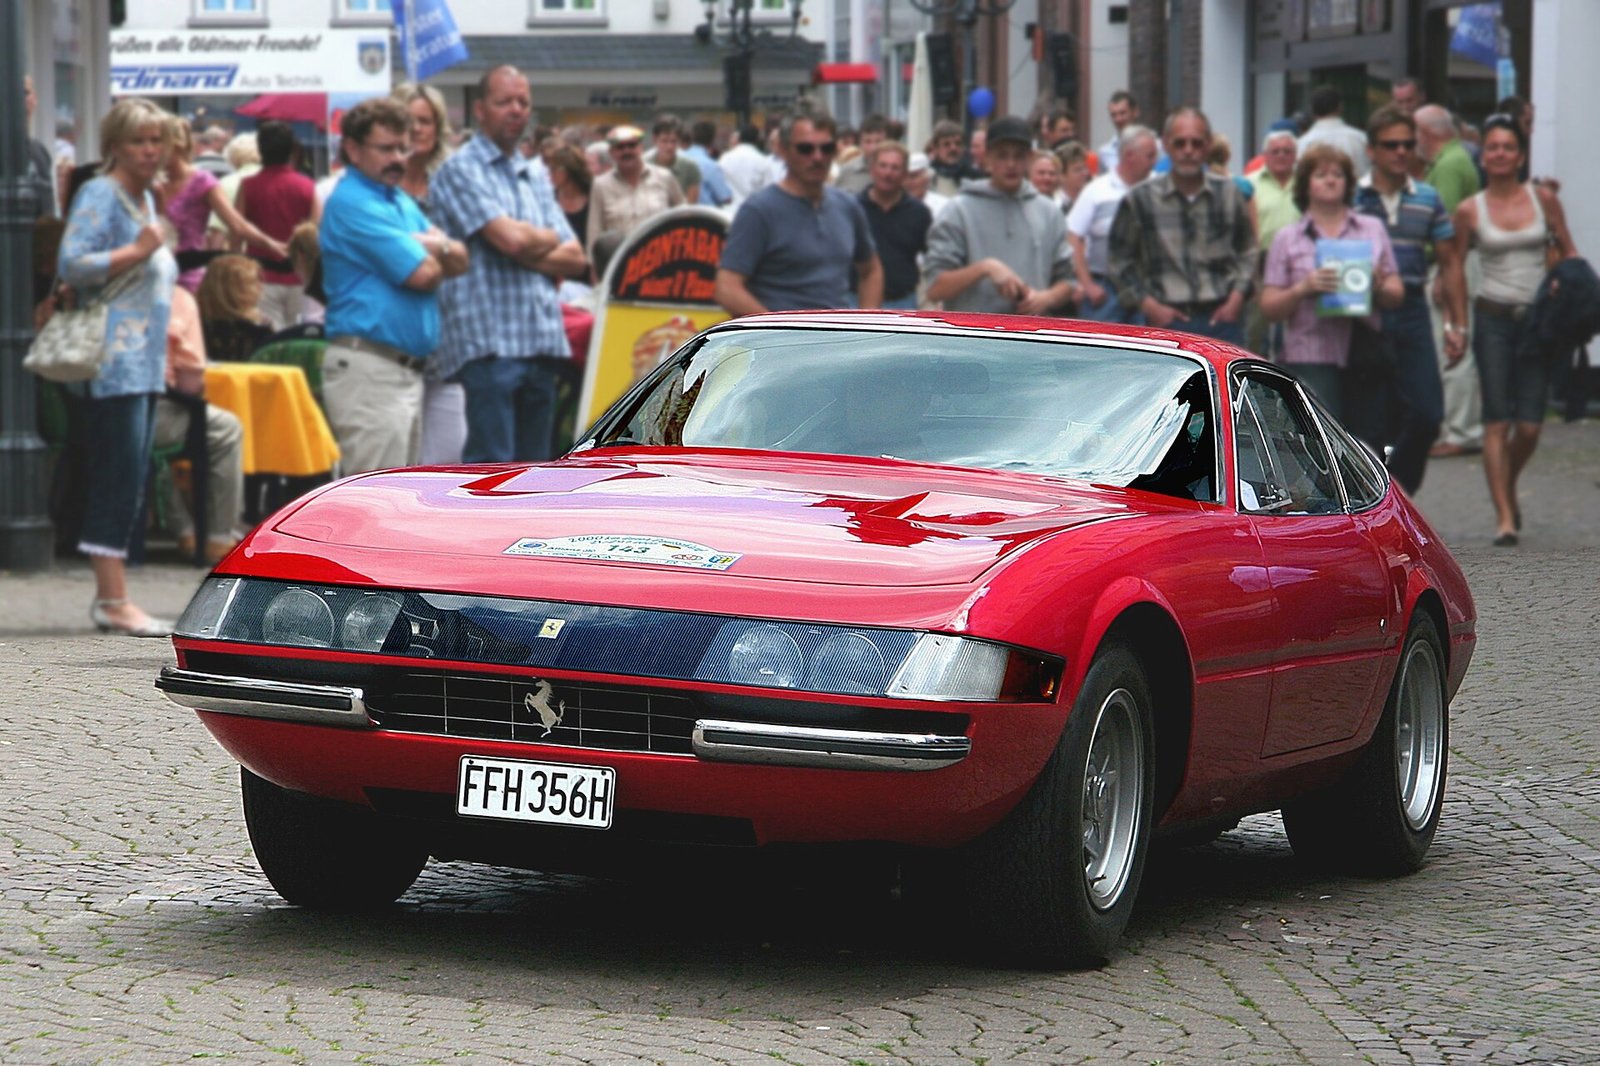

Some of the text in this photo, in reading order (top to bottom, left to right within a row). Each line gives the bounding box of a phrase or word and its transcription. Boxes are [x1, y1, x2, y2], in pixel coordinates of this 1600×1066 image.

[156, 36, 184, 51] alle
[188, 35, 322, 52] Oldtimer-Freunde!
[240, 75, 323, 87] Auto Technik
[608, 544, 651, 554] 143
